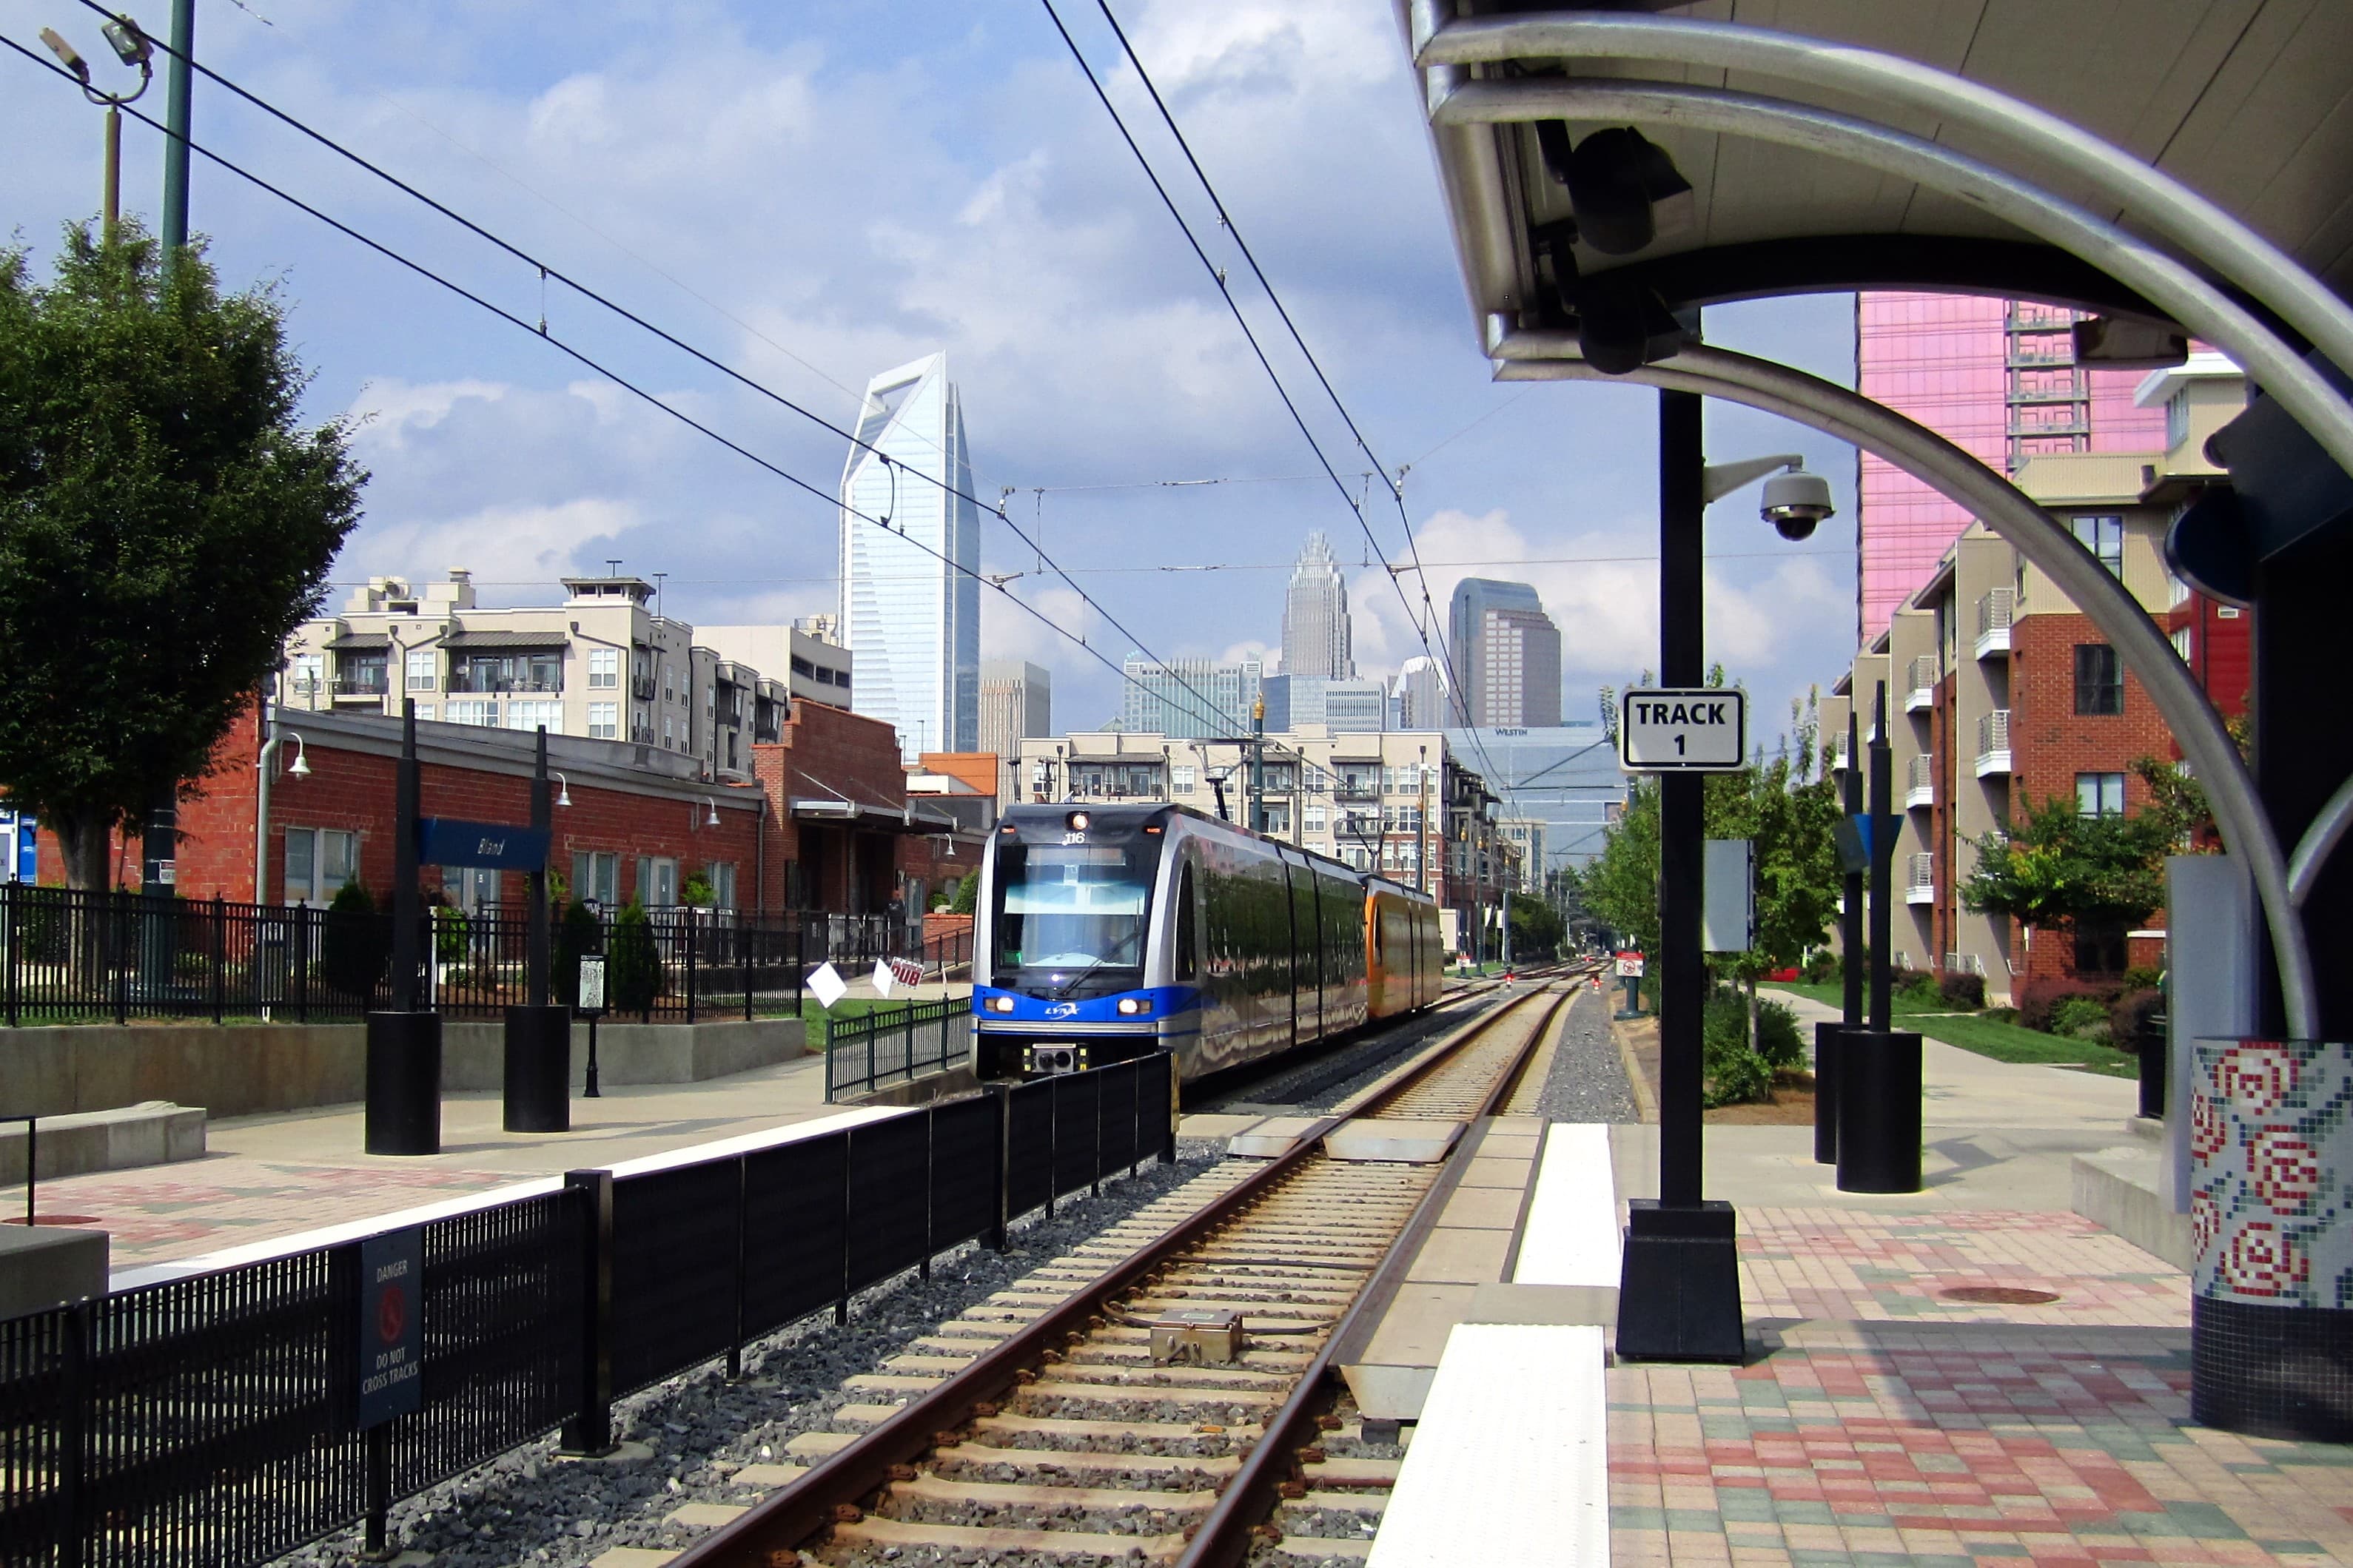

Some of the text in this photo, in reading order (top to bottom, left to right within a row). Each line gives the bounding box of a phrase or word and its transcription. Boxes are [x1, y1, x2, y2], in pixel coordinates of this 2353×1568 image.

[1636, 703, 1726, 725] TRACK
[1674, 734, 1685, 756] 1
[477, 838, 506, 855] Bland
[1065, 832, 1085, 844] 116
[376, 1259, 408, 1283] DANGER
[376, 1346, 406, 1370] DO NOT
[362, 1360, 419, 1395] CROSS TRACKS
